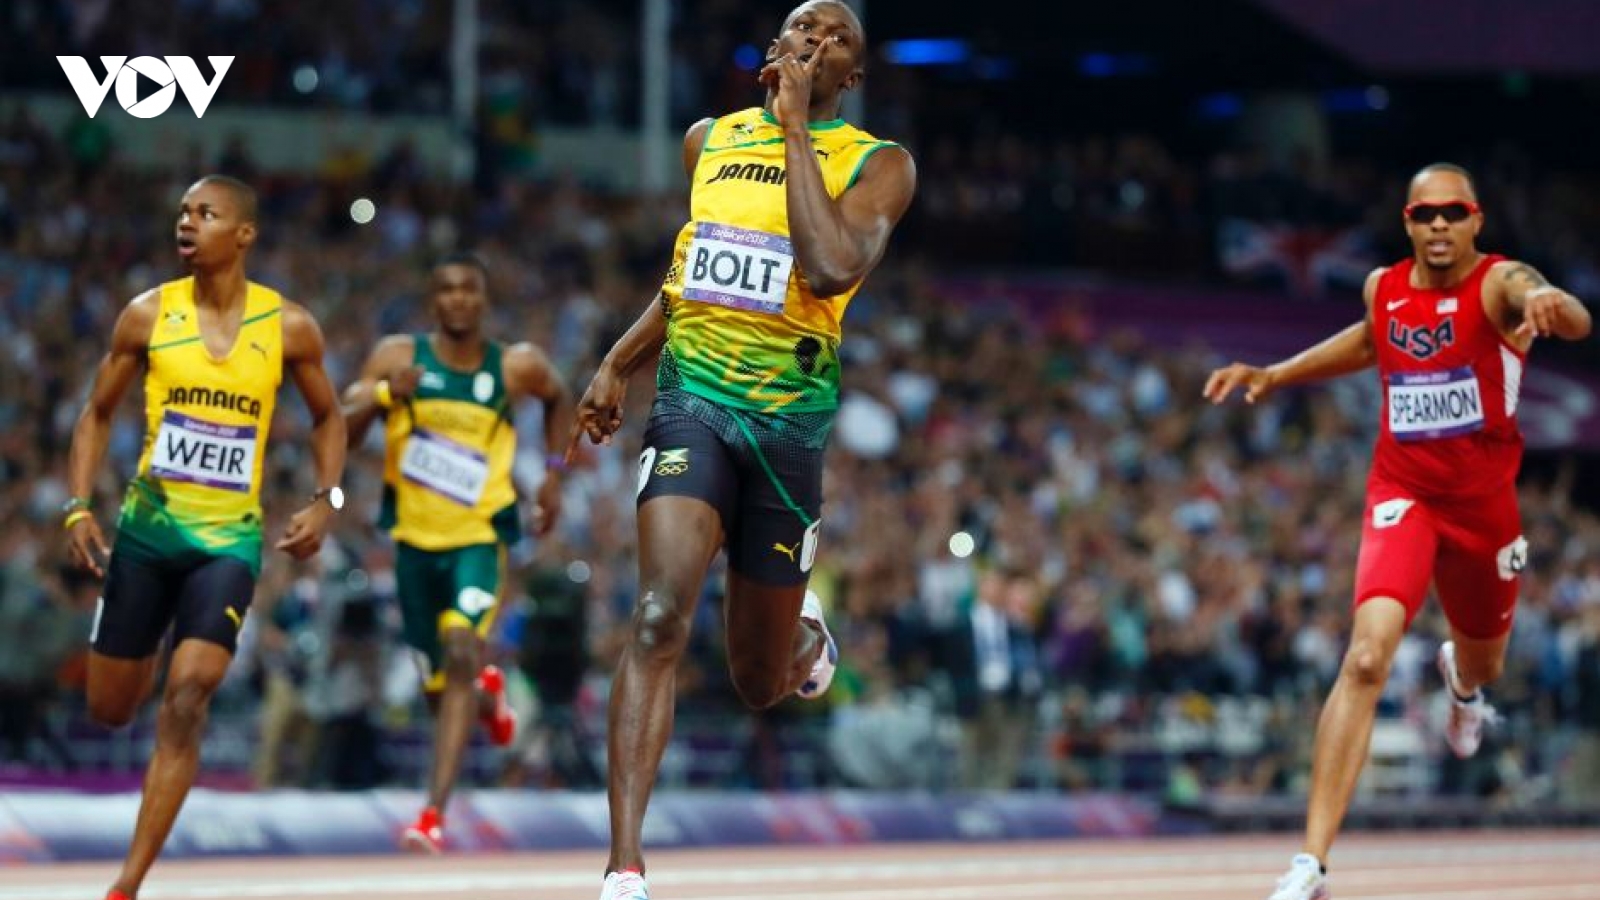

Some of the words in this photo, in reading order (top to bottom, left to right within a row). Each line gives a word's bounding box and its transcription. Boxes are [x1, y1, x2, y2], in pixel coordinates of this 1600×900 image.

[692, 246, 781, 294] BOLT
[1388, 315, 1455, 361] USA
[162, 387, 261, 419] JAMAICA
[1392, 386, 1479, 424] SPEARMON
[167, 431, 246, 476] WEIR
